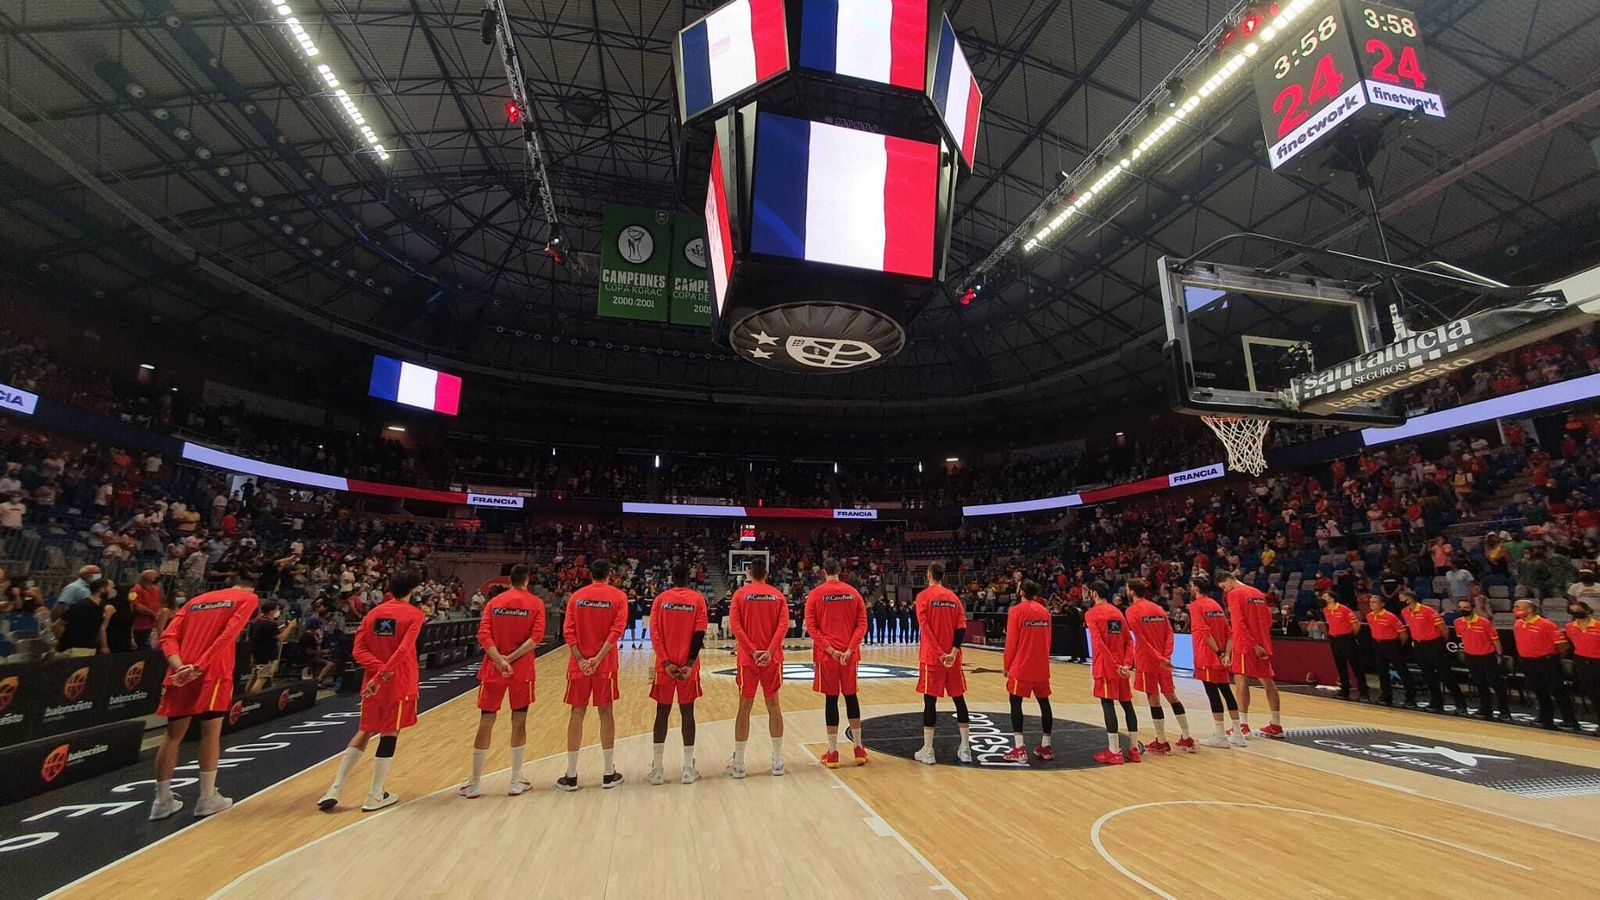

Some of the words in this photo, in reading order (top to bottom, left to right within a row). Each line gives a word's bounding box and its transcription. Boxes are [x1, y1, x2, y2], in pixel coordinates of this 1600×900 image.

[1363, 8, 1417, 38] 3:58
[1273, 15, 1337, 79] 3:58
[1365, 38, 1428, 89] 24
[1272, 52, 1344, 139] 24
[1372, 86, 1440, 112] finetwork
[1276, 93, 1359, 159] finetwork
[602, 269, 665, 288] CAMPEONES
[604, 283, 630, 293] COPA
[612, 296, 654, 308] 2000/2001
[672, 291, 697, 300] COPA
[1354, 361, 1407, 385] SEGUROS
[1173, 468, 1218, 483] FRANCIA
[472, 496, 518, 505] FRANCIA
